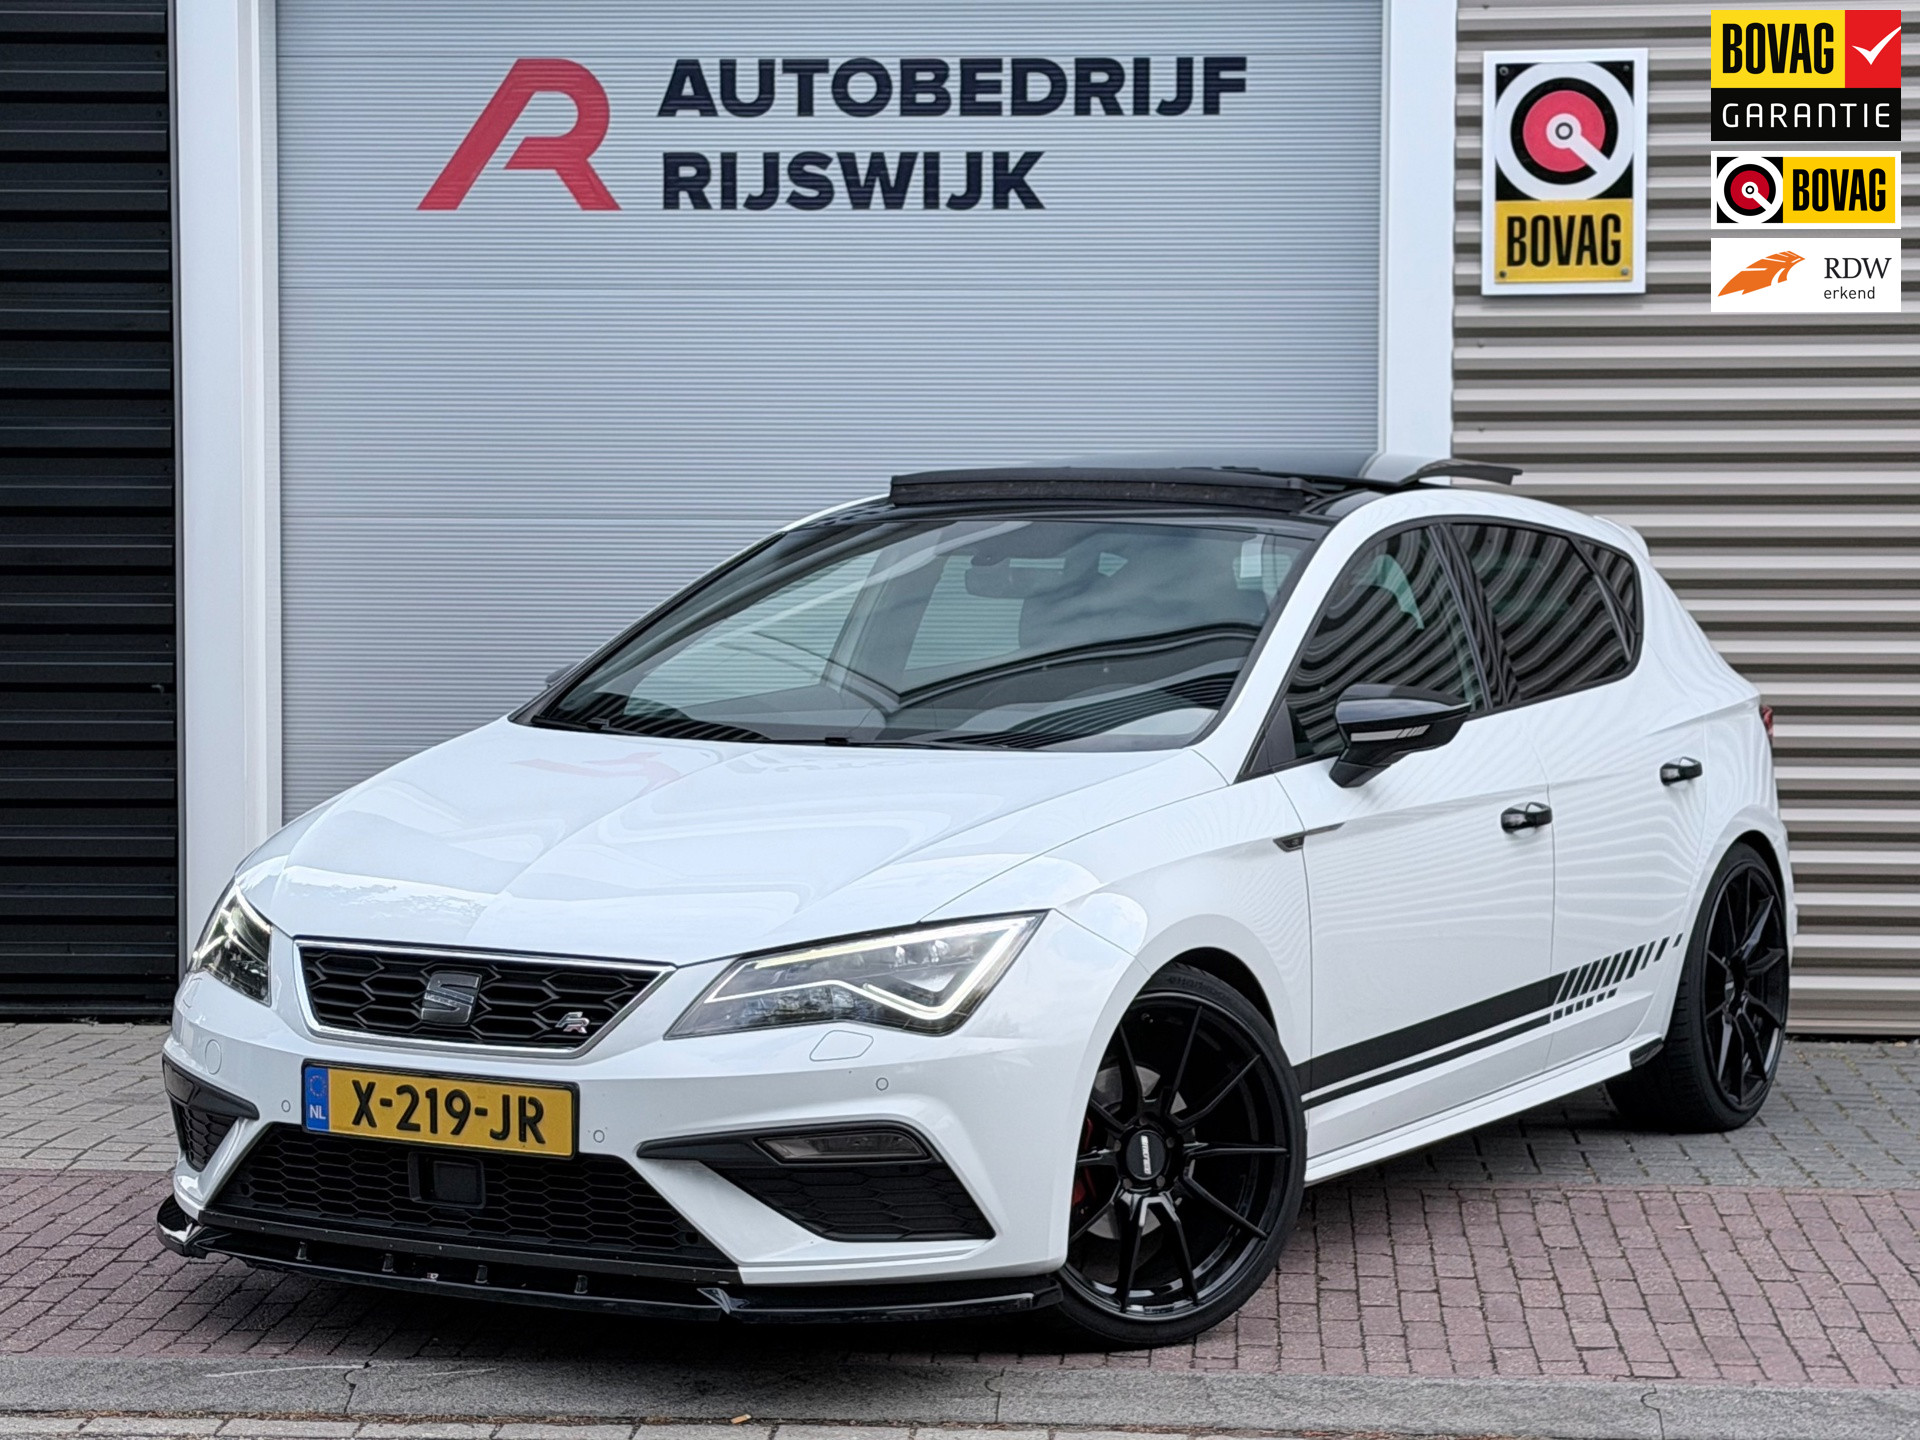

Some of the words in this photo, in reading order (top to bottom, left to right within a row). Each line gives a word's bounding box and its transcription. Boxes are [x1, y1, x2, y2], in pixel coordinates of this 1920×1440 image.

[657, 55, 1248, 118] AUTOBEDRIJF
[662, 150, 1046, 212] RIJSWIJK
[1506, 212, 1622, 268] BOVAG
[309, 1103, 327, 1120] NL
[351, 1079, 546, 1145] X-219-JR
